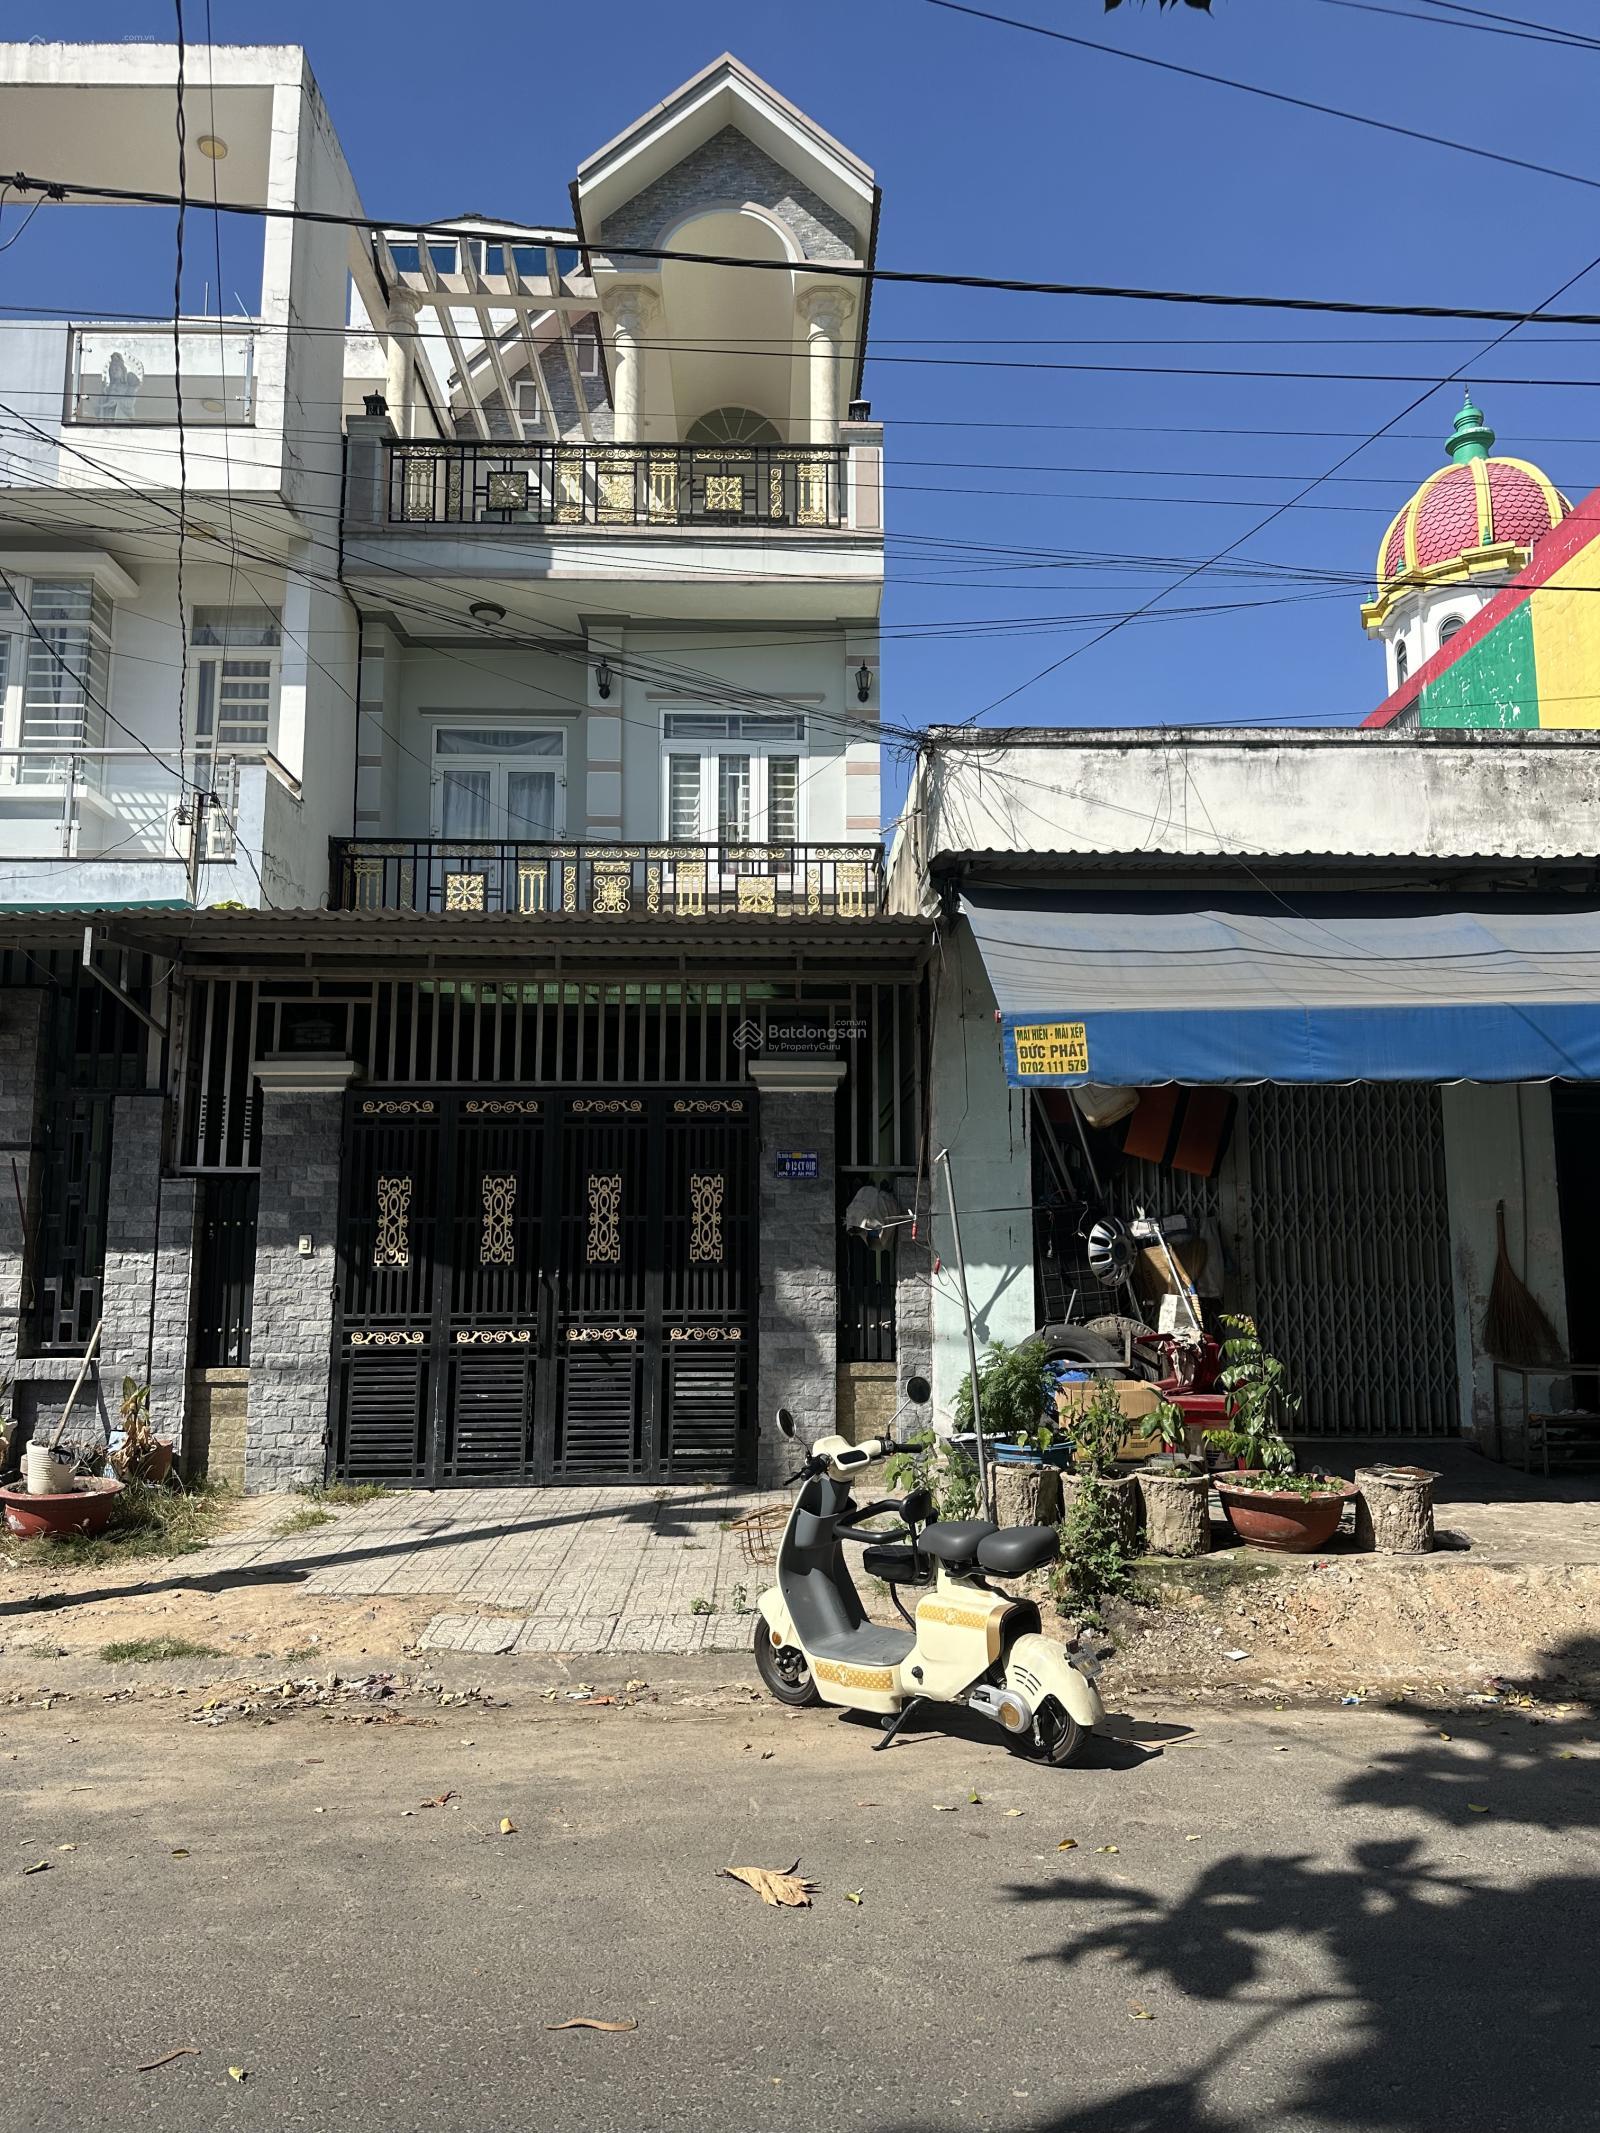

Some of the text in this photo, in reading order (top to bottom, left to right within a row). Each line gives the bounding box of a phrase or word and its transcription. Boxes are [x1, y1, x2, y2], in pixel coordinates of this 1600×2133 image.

[1019, 1041, 1085, 1059] ĐỨC PHÁT
[1020, 1059, 1087, 1073] 0702 111 579
